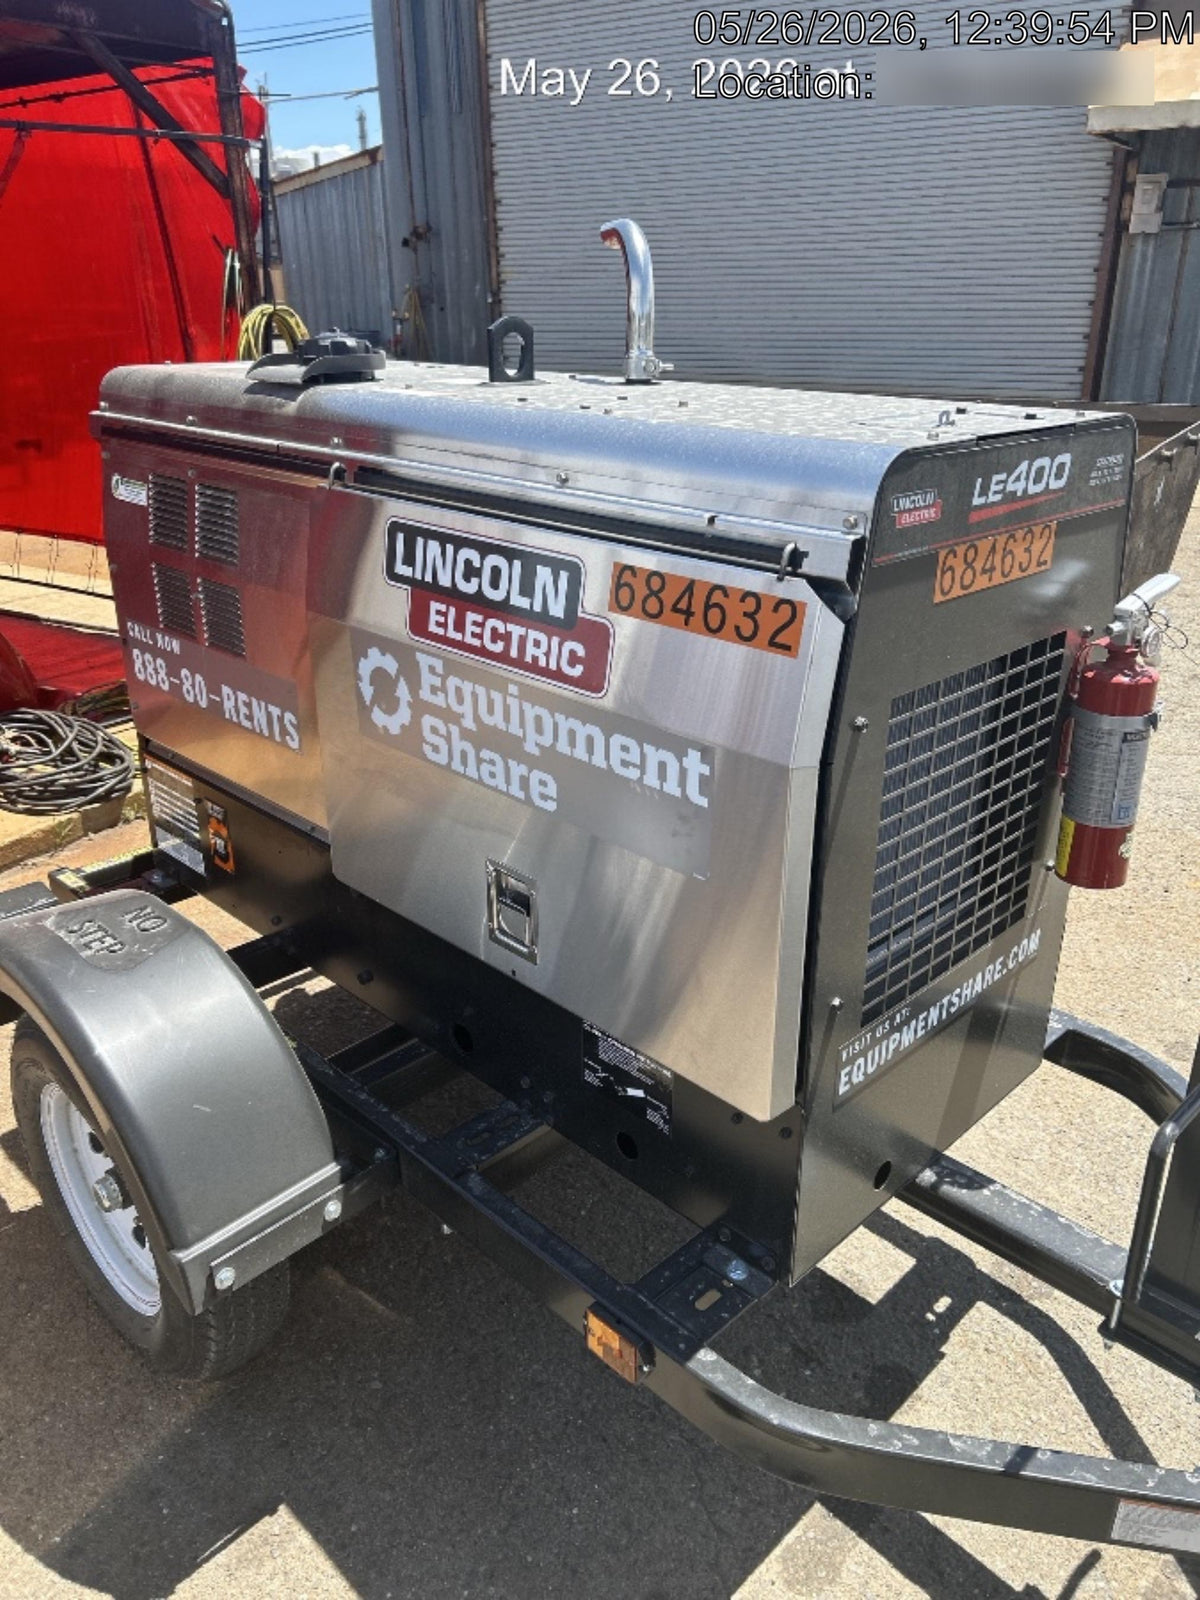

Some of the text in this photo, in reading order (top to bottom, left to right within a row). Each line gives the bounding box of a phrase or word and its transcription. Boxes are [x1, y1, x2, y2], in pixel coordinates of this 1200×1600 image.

[893, 491, 935, 512] LINCOLN
[971, 453, 1072, 506] LE400
[393, 533, 569, 620] LINCOLN
[939, 524, 1053, 597] 684632
[127, 621, 180, 655] CALL NOW
[427, 600, 585, 678] ELECTRIC
[614, 565, 798, 652] 684632
[132, 648, 299, 749] 888-80-RENTS
[415, 651, 709, 808] Equipment
[421, 714, 557, 812] Share
[838, 928, 1042, 1096] EQUIPMENTSHARE.COM
[842, 1007, 911, 1062] VISIT US AT:
